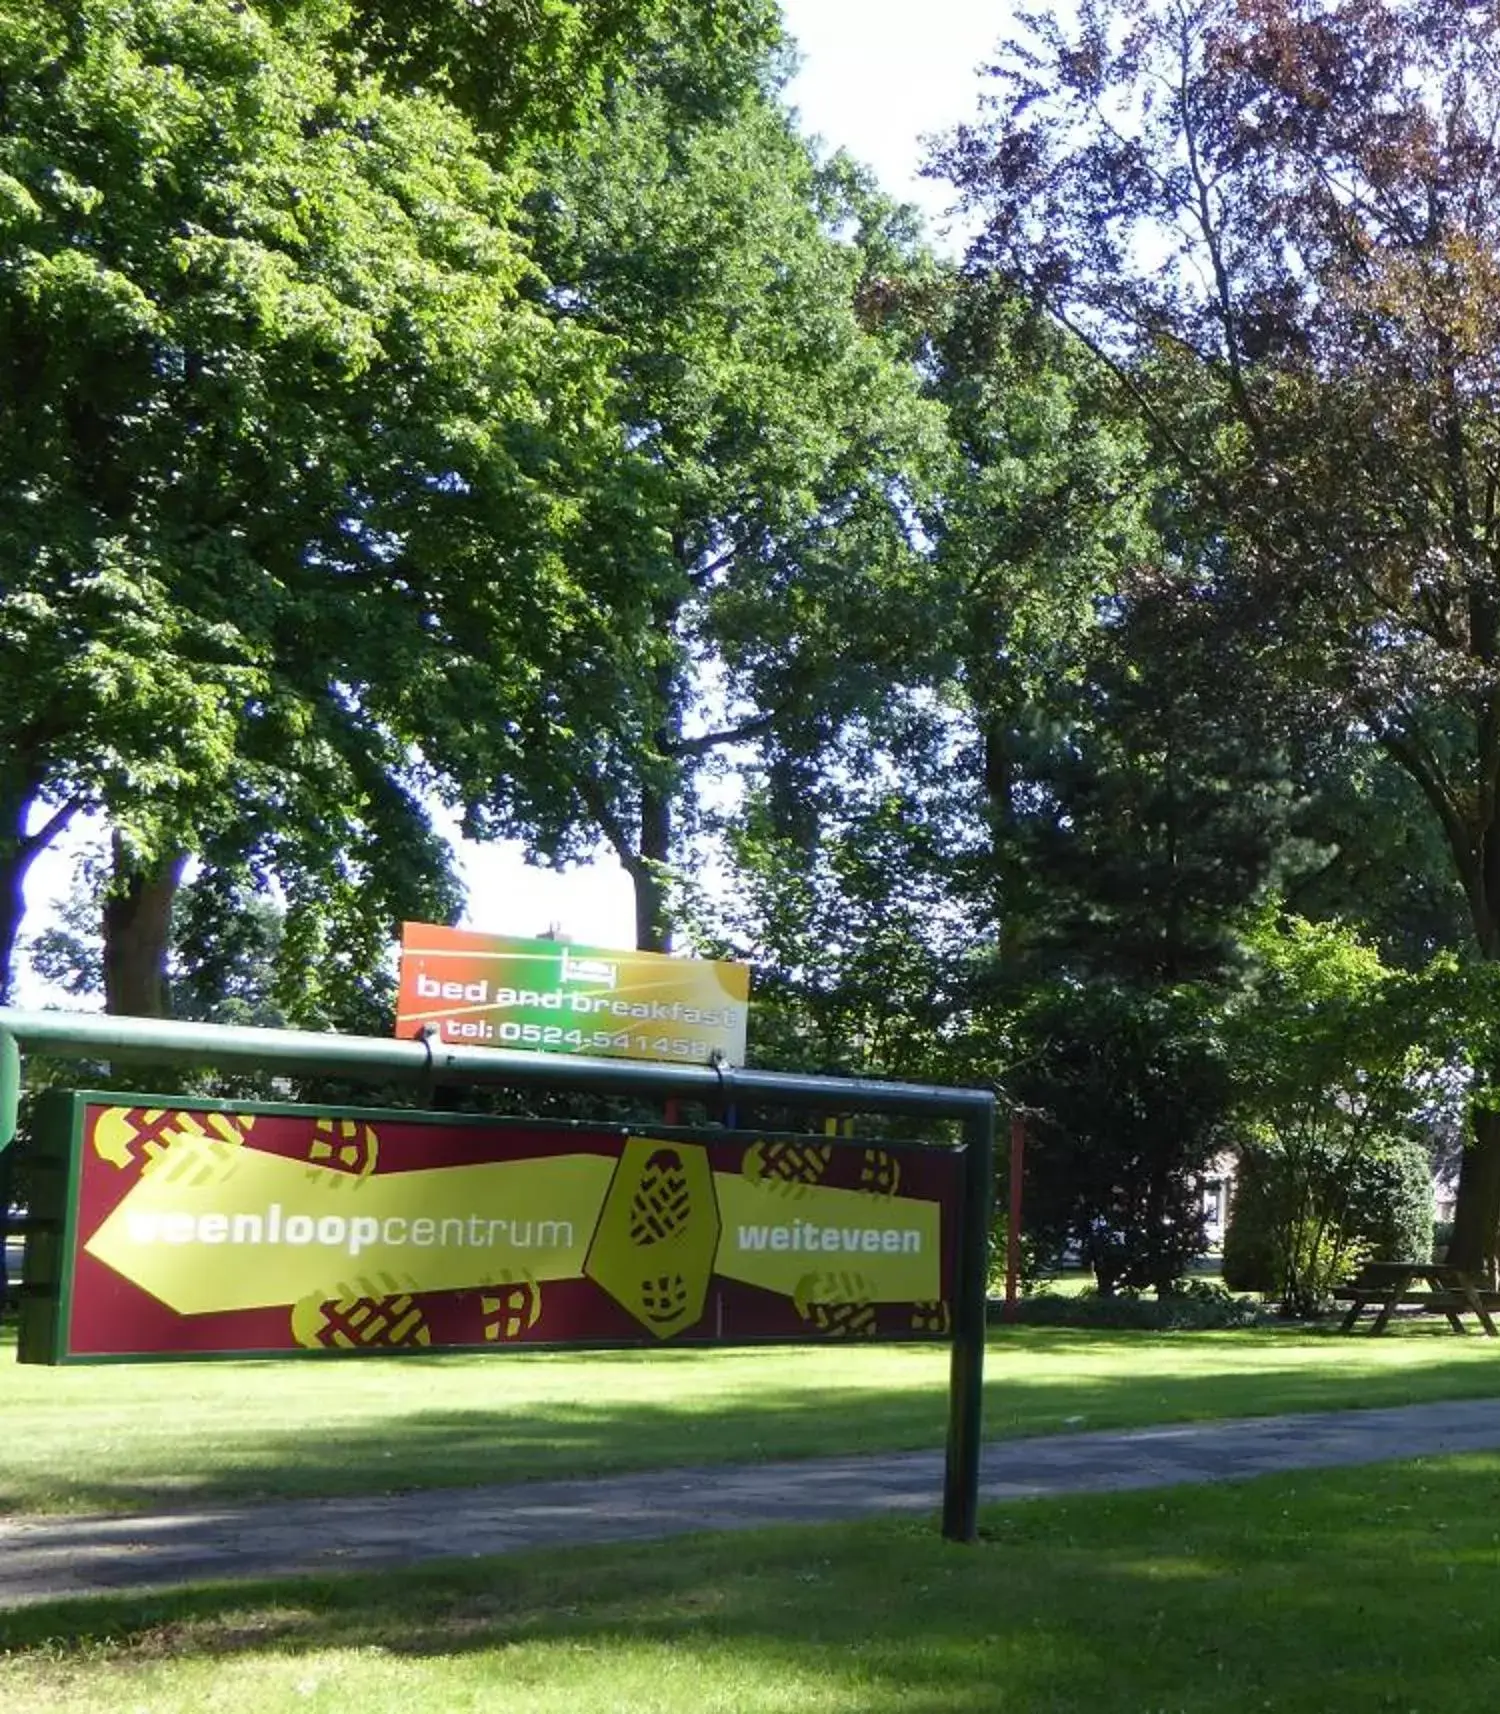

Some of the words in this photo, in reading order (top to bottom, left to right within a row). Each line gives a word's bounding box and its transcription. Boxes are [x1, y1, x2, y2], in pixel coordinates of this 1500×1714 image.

[416, 973, 488, 1002] bed
[496, 986, 563, 1010] and
[570, 993, 738, 1029] breakfast
[447, 1020, 493, 1039] tel:
[124, 1203, 574, 1255] veenloopcentrum
[737, 1217, 922, 1253] weiteveen
